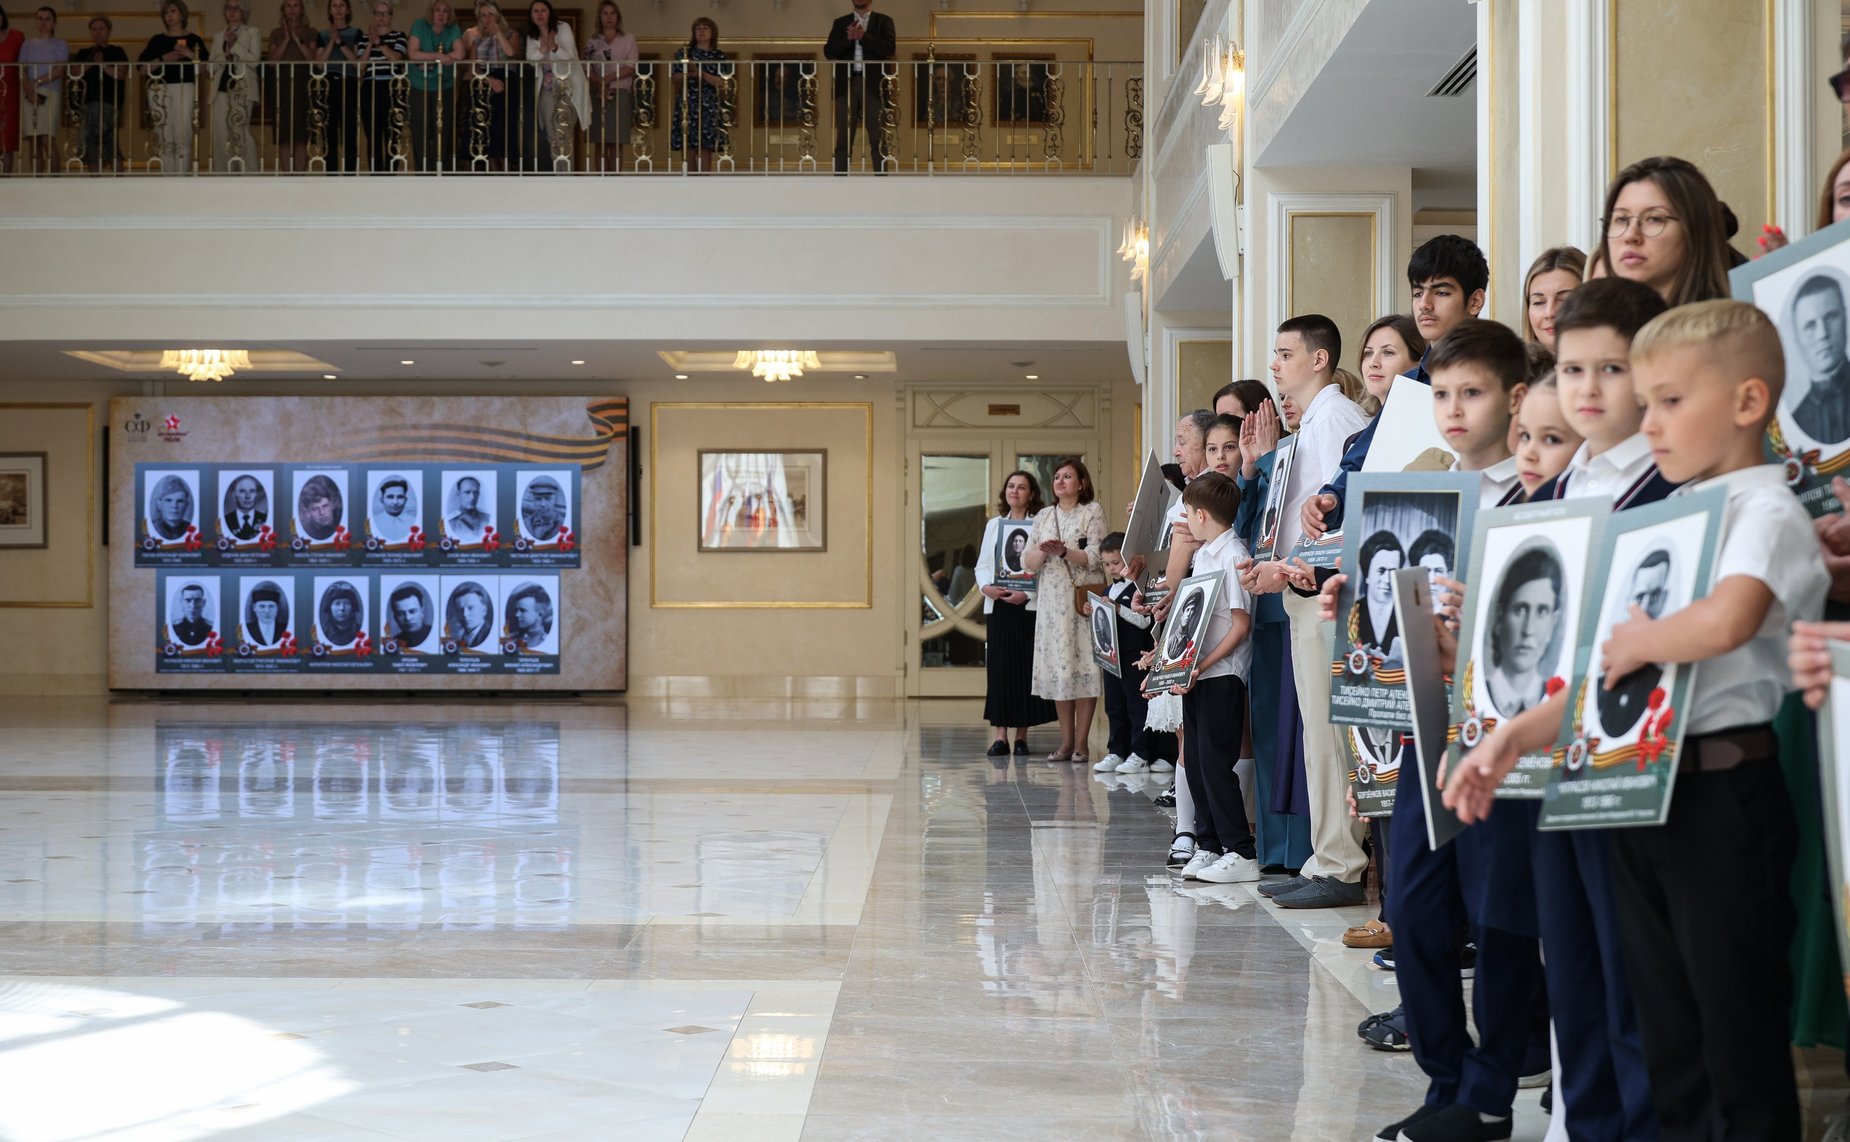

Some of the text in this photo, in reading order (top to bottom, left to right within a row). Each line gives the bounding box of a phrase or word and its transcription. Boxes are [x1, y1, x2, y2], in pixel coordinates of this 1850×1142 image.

[1340, 685, 1371, 697] ТИСЕЙКО
[1371, 687, 1389, 698] ПЕТР
[1331, 695, 1361, 707] ТИСЕЙКО
[1361, 697, 1396, 709] ДМИТРИЙ
